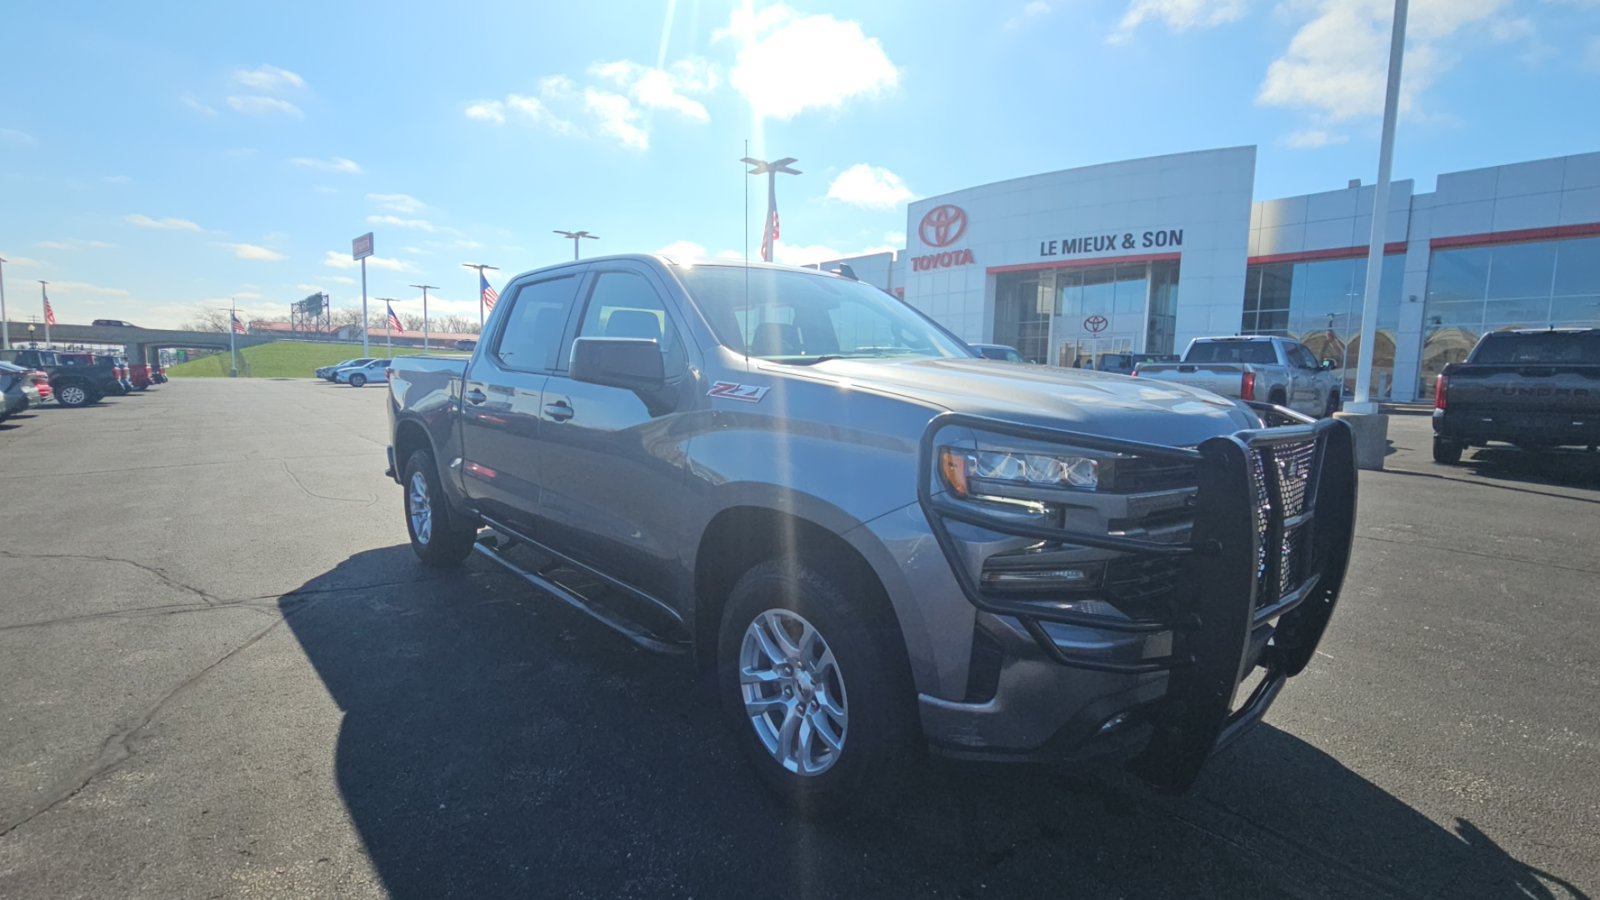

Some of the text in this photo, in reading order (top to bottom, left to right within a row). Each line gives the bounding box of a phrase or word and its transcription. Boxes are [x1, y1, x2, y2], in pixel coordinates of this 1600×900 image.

[1040, 229, 1184, 257] LE MIEUX & SON
[911, 248, 976, 272] TOYOTA
[1484, 385, 1590, 398] TUNDRA
